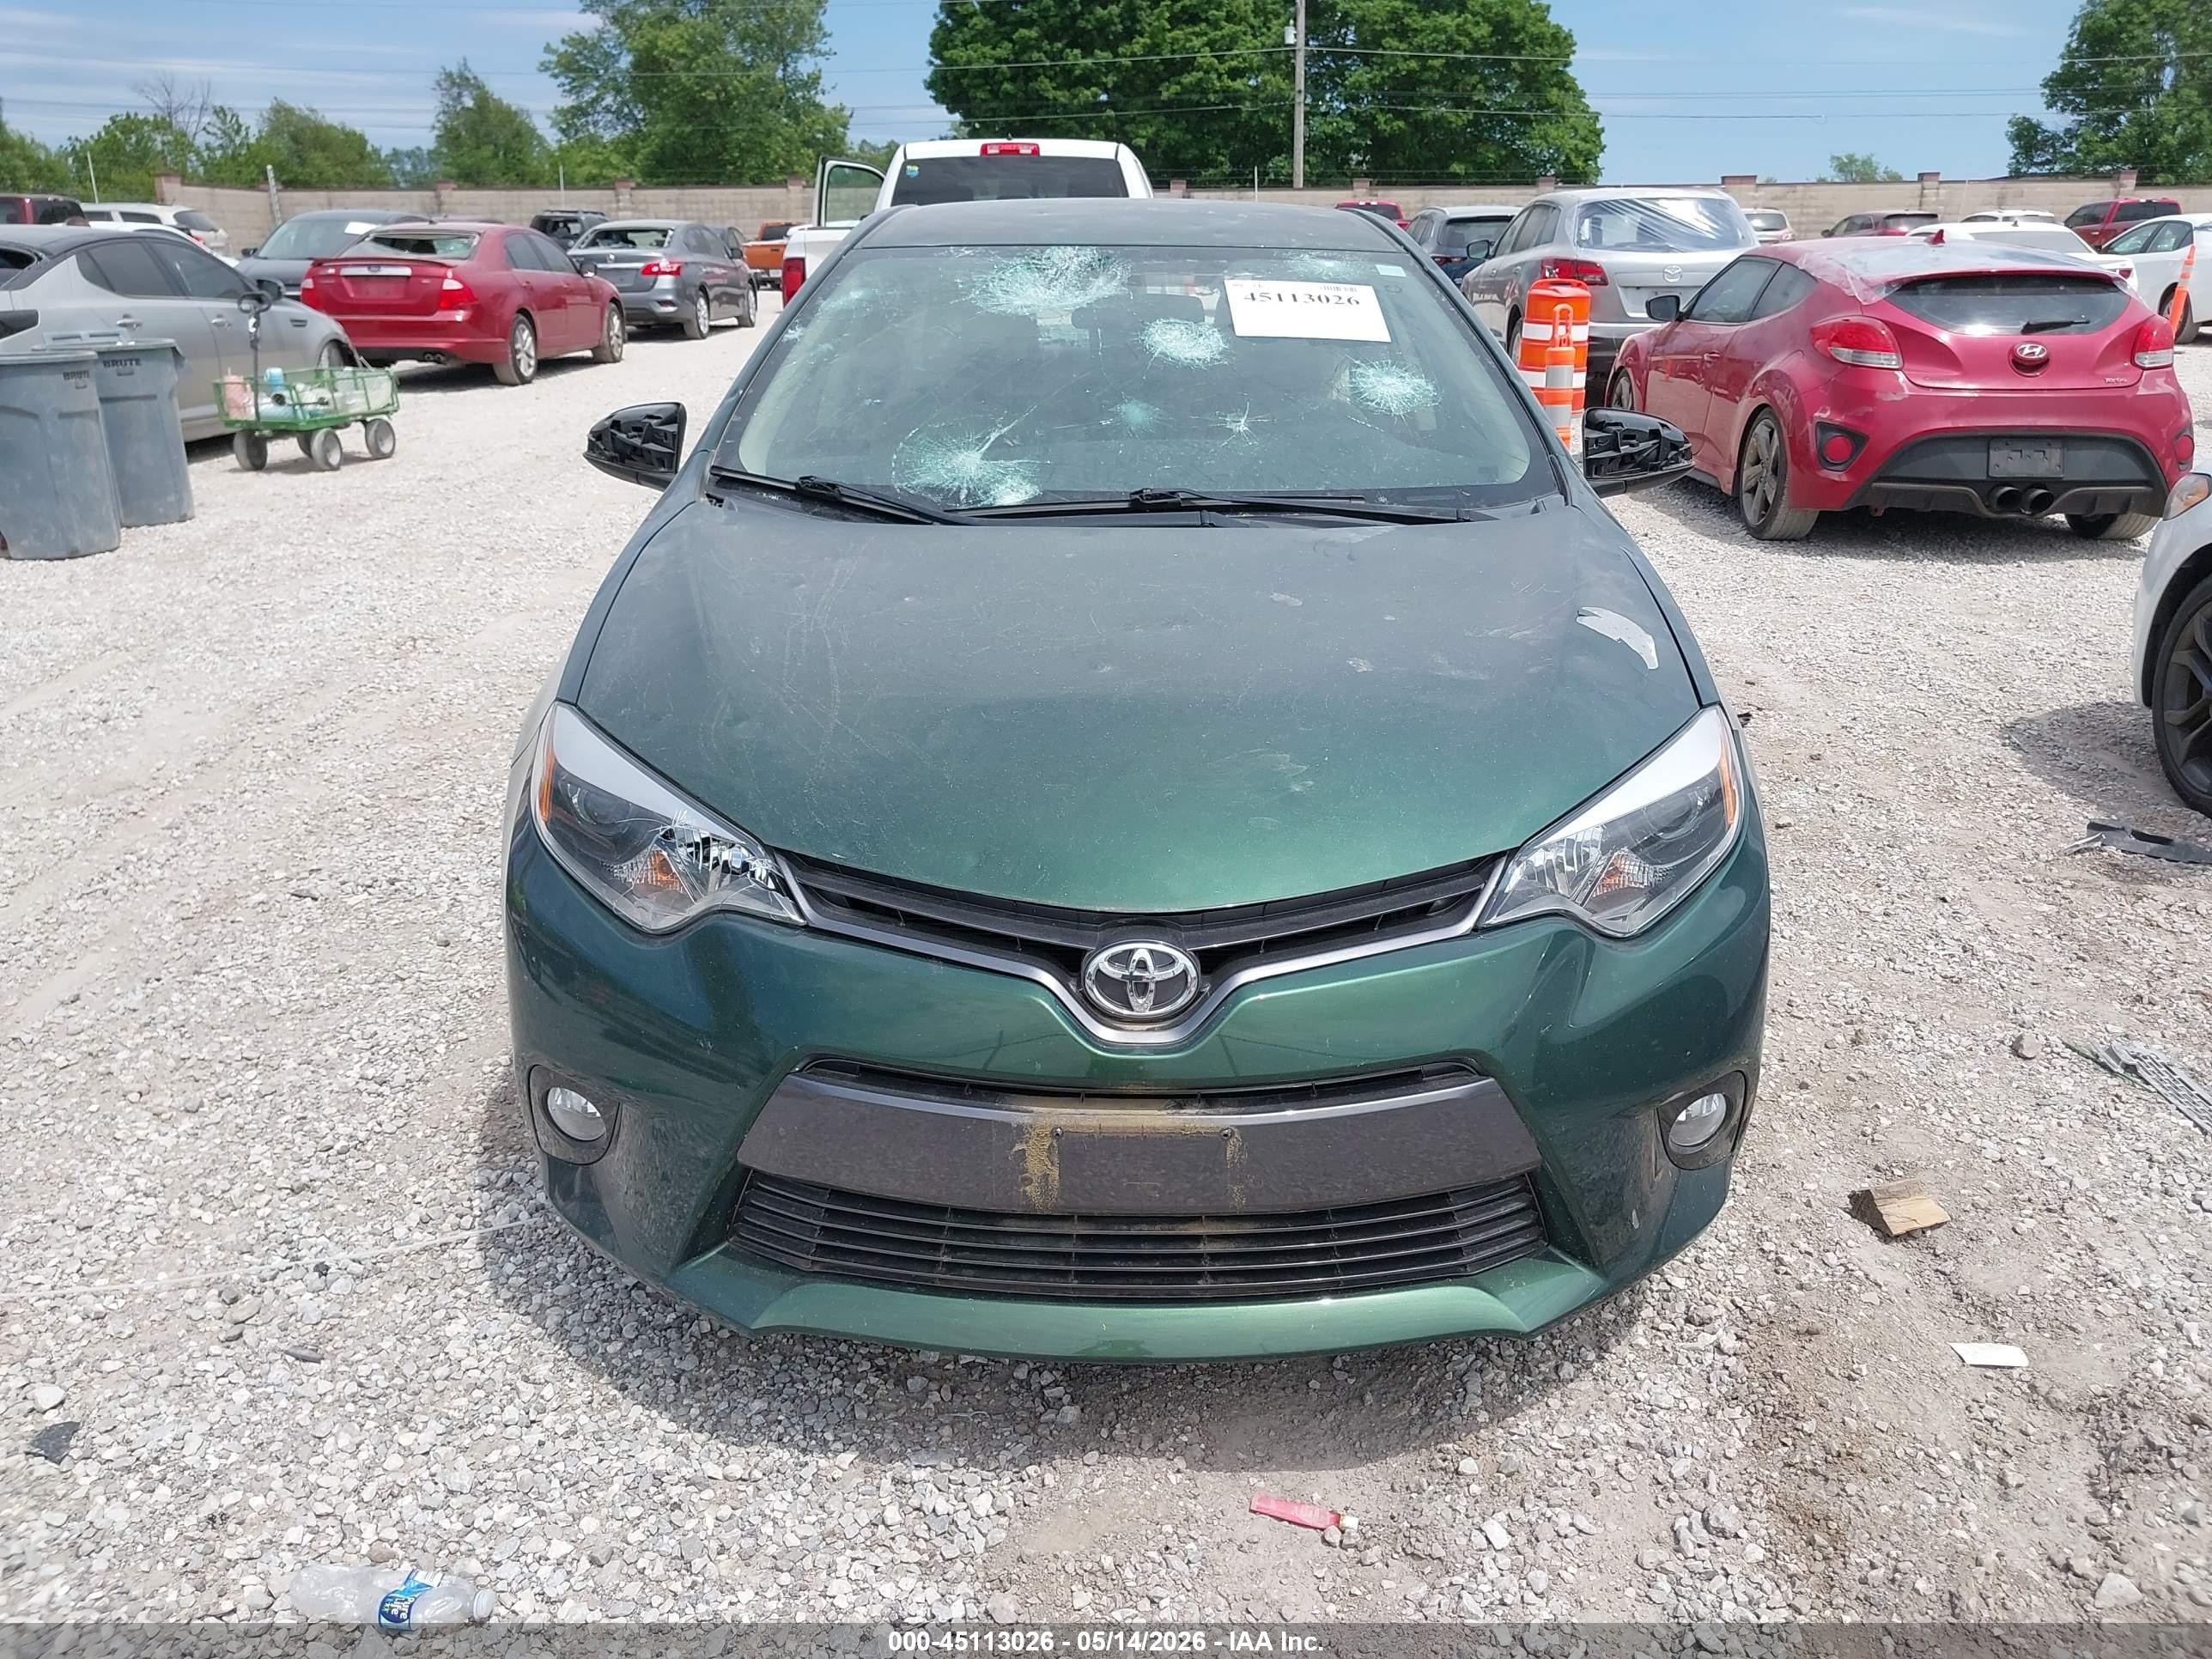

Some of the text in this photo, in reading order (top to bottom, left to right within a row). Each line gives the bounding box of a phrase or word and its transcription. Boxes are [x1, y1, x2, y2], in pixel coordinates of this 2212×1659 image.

[1243, 292, 1359, 306] 45113026
[102, 357, 142, 368] BRUTE
[391, 1597, 404, 1615] Life
[400, 1597, 415, 1620] Pure
